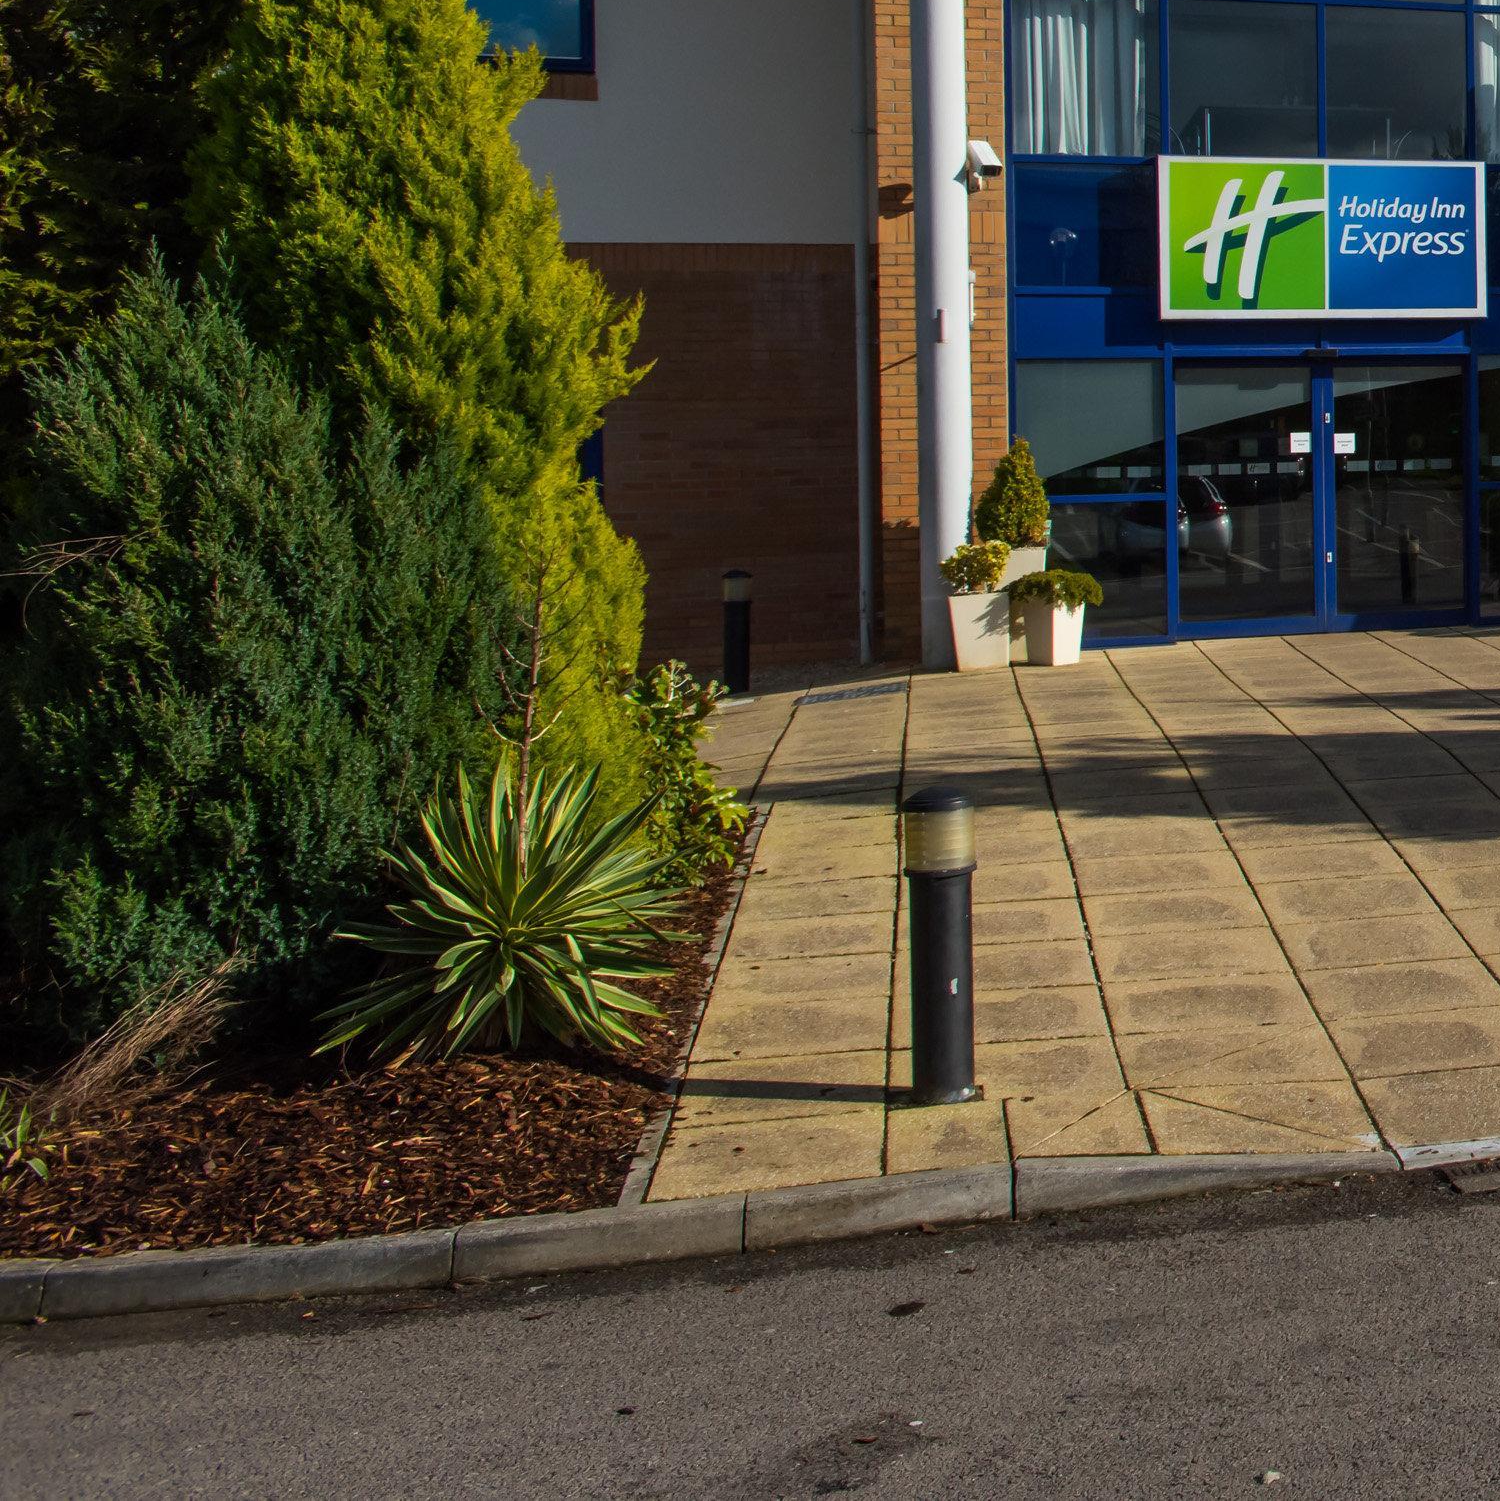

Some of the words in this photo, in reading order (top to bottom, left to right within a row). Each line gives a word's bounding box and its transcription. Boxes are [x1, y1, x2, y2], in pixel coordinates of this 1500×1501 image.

[1338, 195, 1427, 223] Holiday
[1430, 196, 1465, 218] Inn
[1339, 224, 1466, 263] Express
